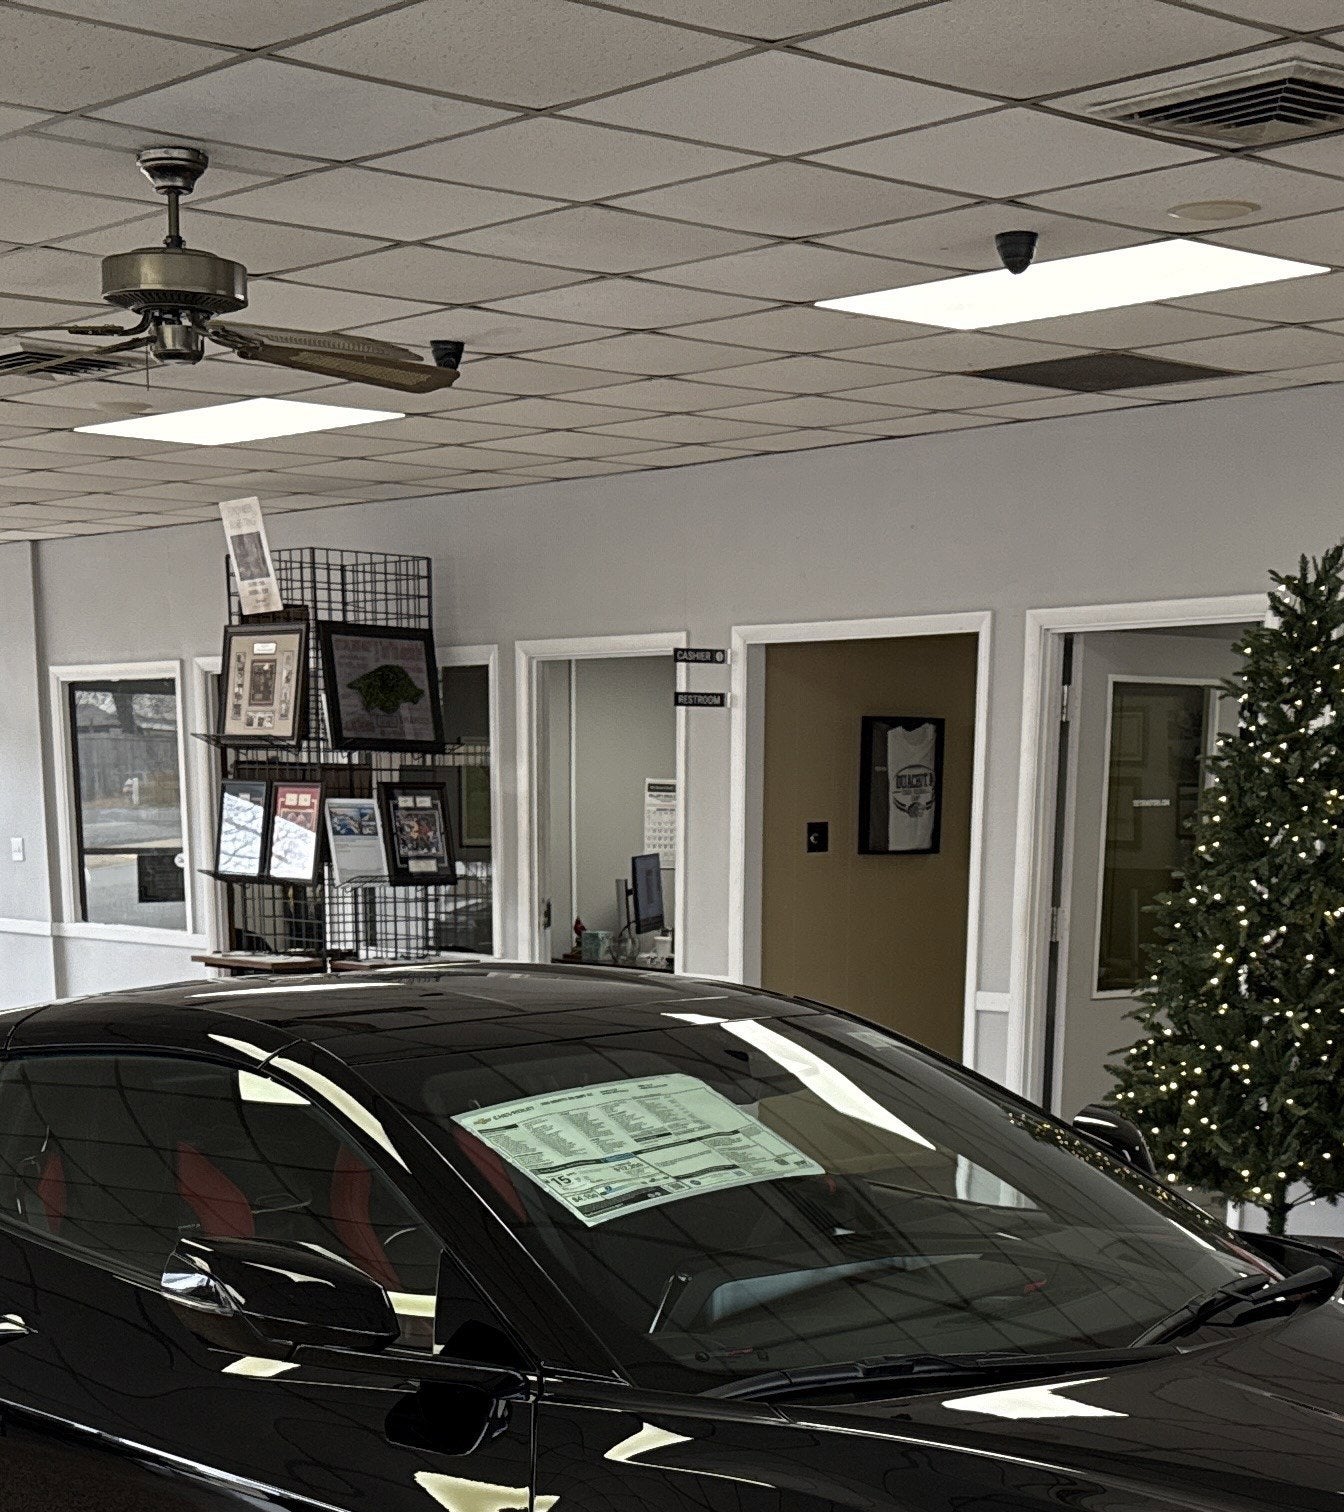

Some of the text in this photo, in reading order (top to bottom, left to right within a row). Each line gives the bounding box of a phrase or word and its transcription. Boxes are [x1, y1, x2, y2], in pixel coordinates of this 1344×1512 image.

[676, 650, 711, 660] CASHIER
[677, 695, 720, 704] RESTROOM
[493, 1105, 534, 1120] CHEVROLET
[550, 1175, 572, 1186] 15
